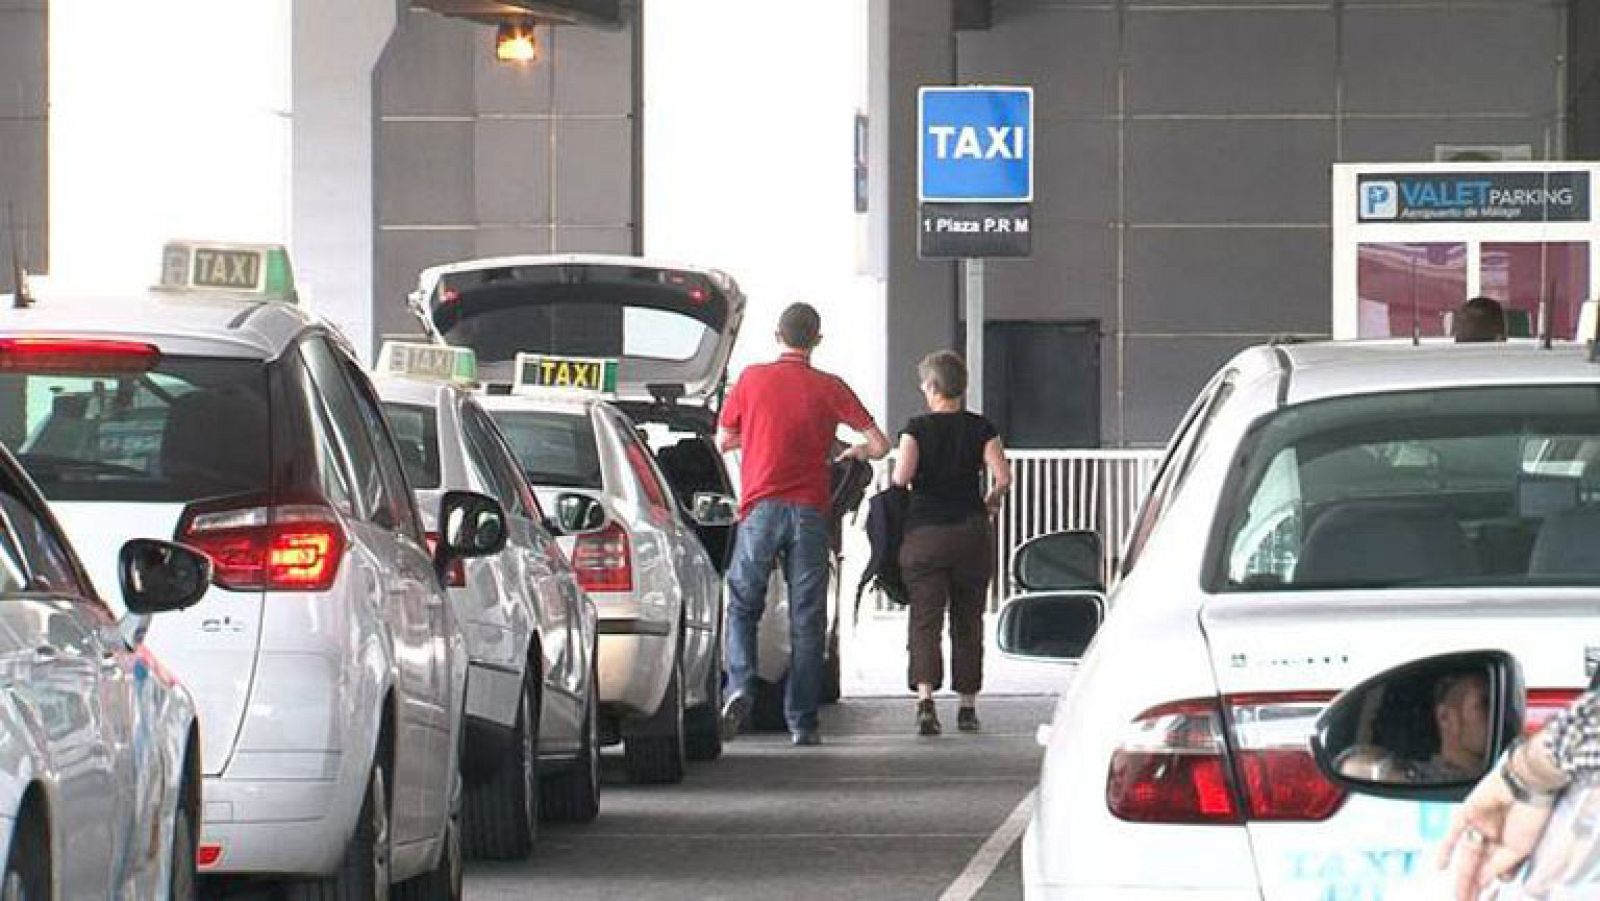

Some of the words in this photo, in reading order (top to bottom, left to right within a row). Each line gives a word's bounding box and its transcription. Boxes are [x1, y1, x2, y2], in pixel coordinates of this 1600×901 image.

[928, 125, 1024, 160] TAXI
[1400, 178, 1492, 206] VALET
[1489, 187, 1573, 205] PARKING
[924, 218, 932, 233] 1
[936, 218, 980, 233] Plaza
[1464, 206, 1478, 218] de
[196, 251, 258, 284] TAXI
[409, 347, 451, 374] TAXI
[541, 360, 598, 389] TAXI
